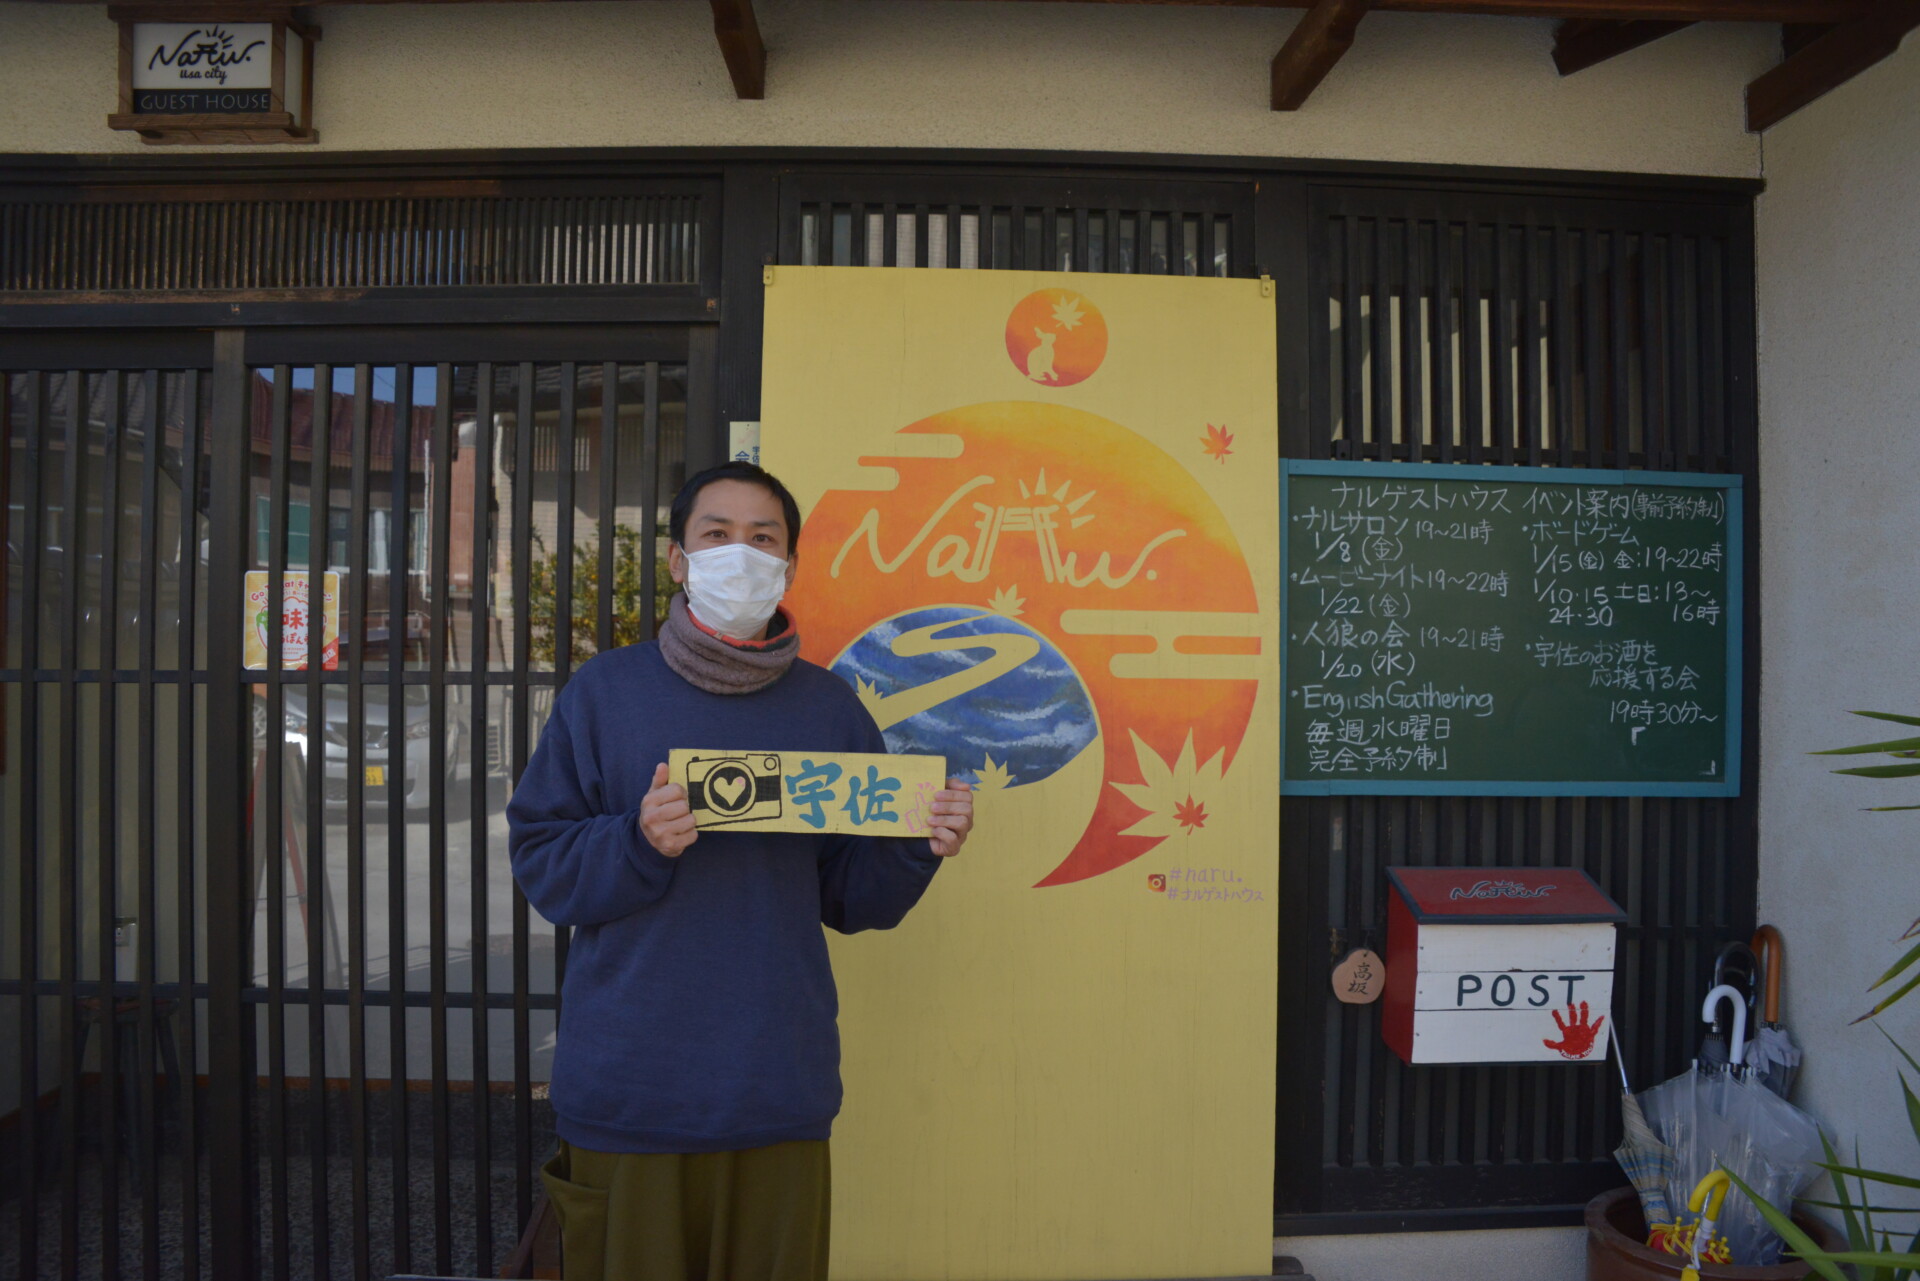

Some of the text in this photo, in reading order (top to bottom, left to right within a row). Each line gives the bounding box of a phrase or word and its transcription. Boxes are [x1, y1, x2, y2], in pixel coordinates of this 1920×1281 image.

[179, 66, 227, 85] usa city
[140, 94, 268, 110] GUEST HOUSE
[1331, 481, 1512, 514] ナルゲストハウス
[1533, 543, 1573, 574] 1/15
[1321, 587, 1364, 616] 1/22
[1673, 598, 1721, 626] 16時
[1321, 650, 1362, 679] 1/20
[1589, 664, 1700, 692] 応援する会
[1306, 714, 1450, 745] 毎週水曜日
[1309, 743, 1447, 773] 完全予約制
[785, 759, 902, 829] 宇佐
[1456, 975, 1585, 1007] POST
